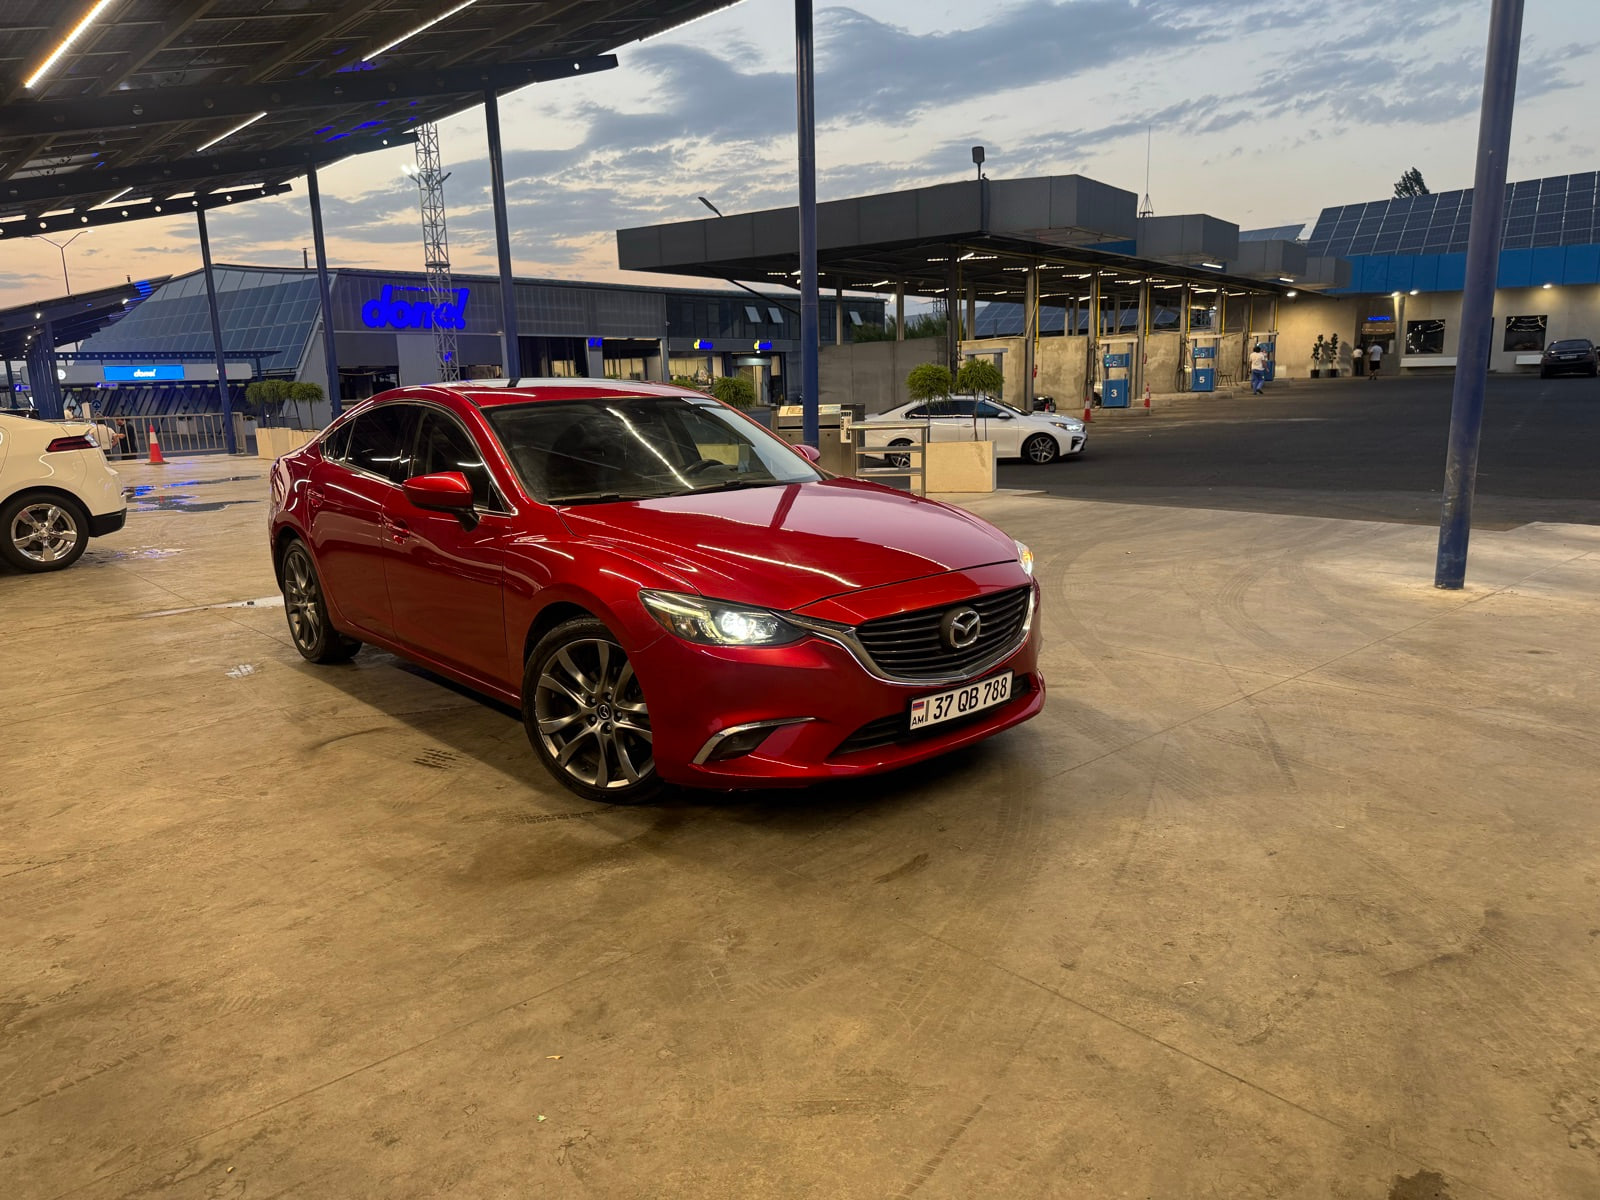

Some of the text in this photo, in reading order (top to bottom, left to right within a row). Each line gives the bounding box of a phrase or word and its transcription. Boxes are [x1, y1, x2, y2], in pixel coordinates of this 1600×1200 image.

[1199, 376, 1205, 384] 5
[1111, 389, 1118, 398] 3
[933, 676, 1008, 720] 37 QB 788
[911, 715, 924, 726] AM
